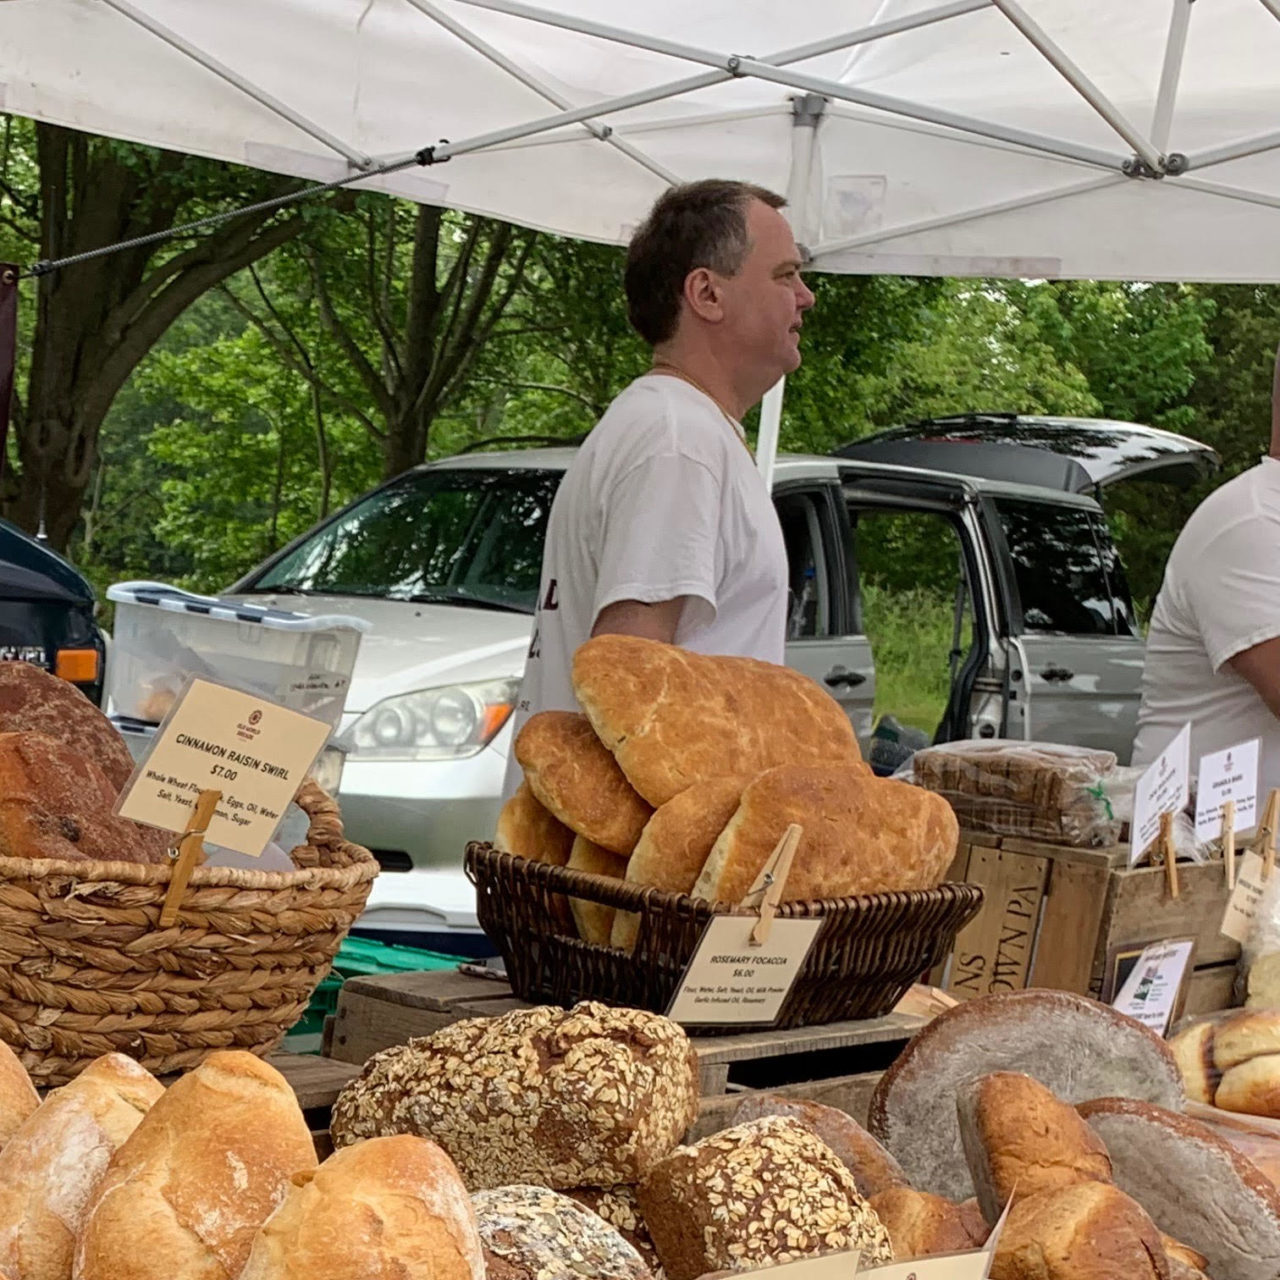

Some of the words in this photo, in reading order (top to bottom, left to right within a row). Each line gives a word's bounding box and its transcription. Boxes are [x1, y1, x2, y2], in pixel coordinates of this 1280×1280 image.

[175, 733, 227, 758] CINNAMON
[227, 749, 262, 770] RAISIN
[261, 762, 289, 780] SWIRL
[210, 764, 238, 781] $7.00
[710, 955, 751, 965] ROSEMARY
[751, 956, 787, 965] FOCACCIA
